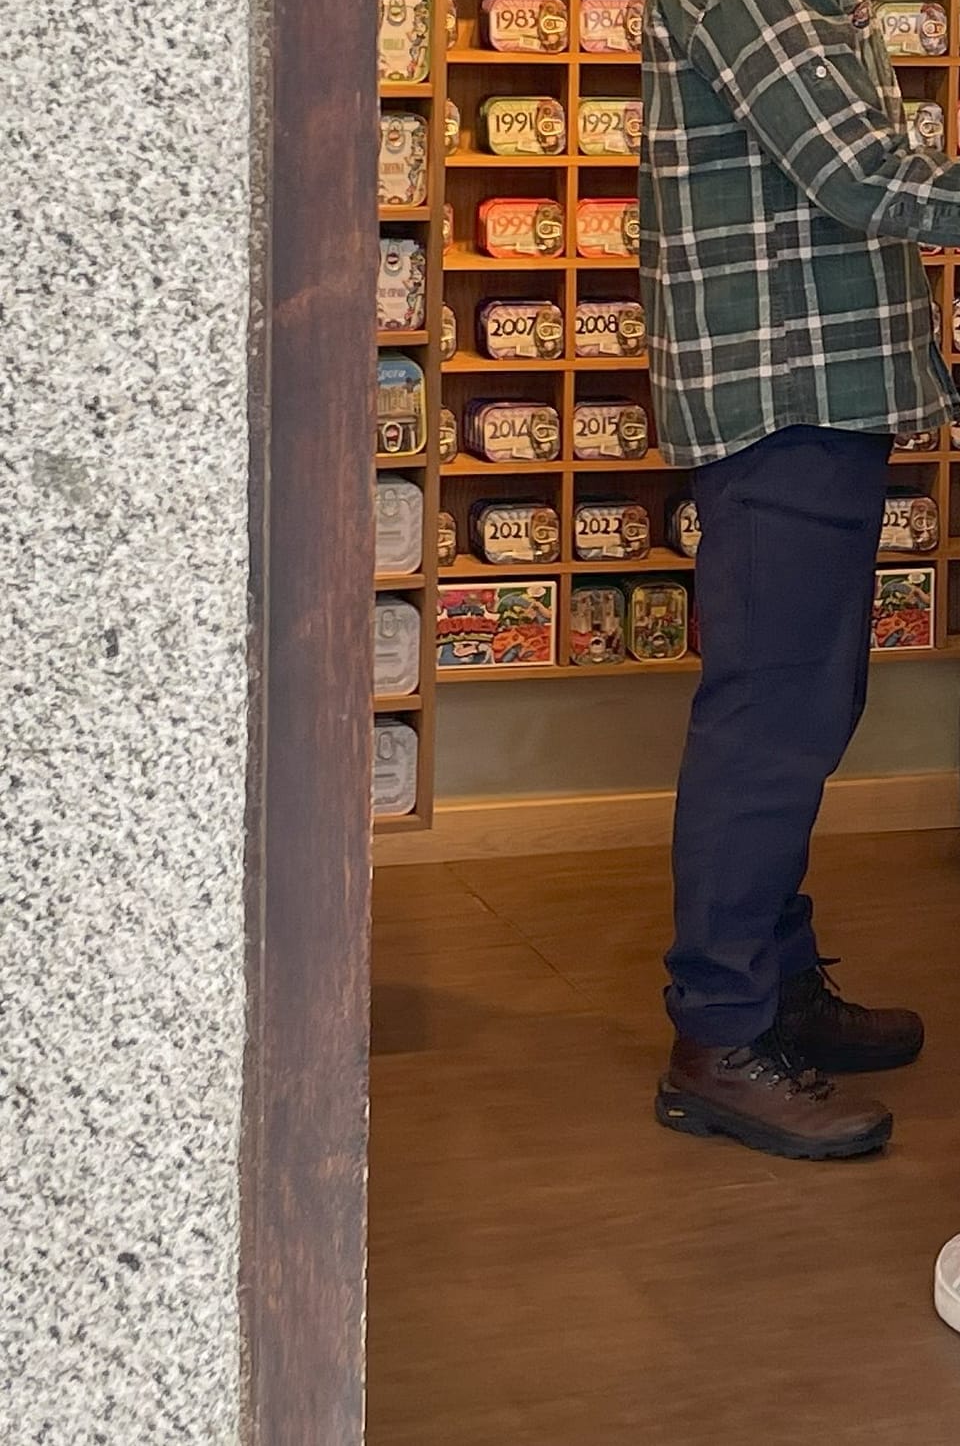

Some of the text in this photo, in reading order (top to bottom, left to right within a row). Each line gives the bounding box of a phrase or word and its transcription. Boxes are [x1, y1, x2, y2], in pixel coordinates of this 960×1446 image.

[495, 10, 538, 30] 1983
[882, 11, 920, 34] 1987
[494, 111, 535, 132] 1991
[581, 112, 624, 132] 1992
[489, 316, 537, 337] 2007
[575, 314, 620, 334] 2008
[575, 418, 620, 438] 2015
[489, 521, 530, 540] 2021
[578, 519, 623, 536] 2022
[883, 512, 910, 529] 025
